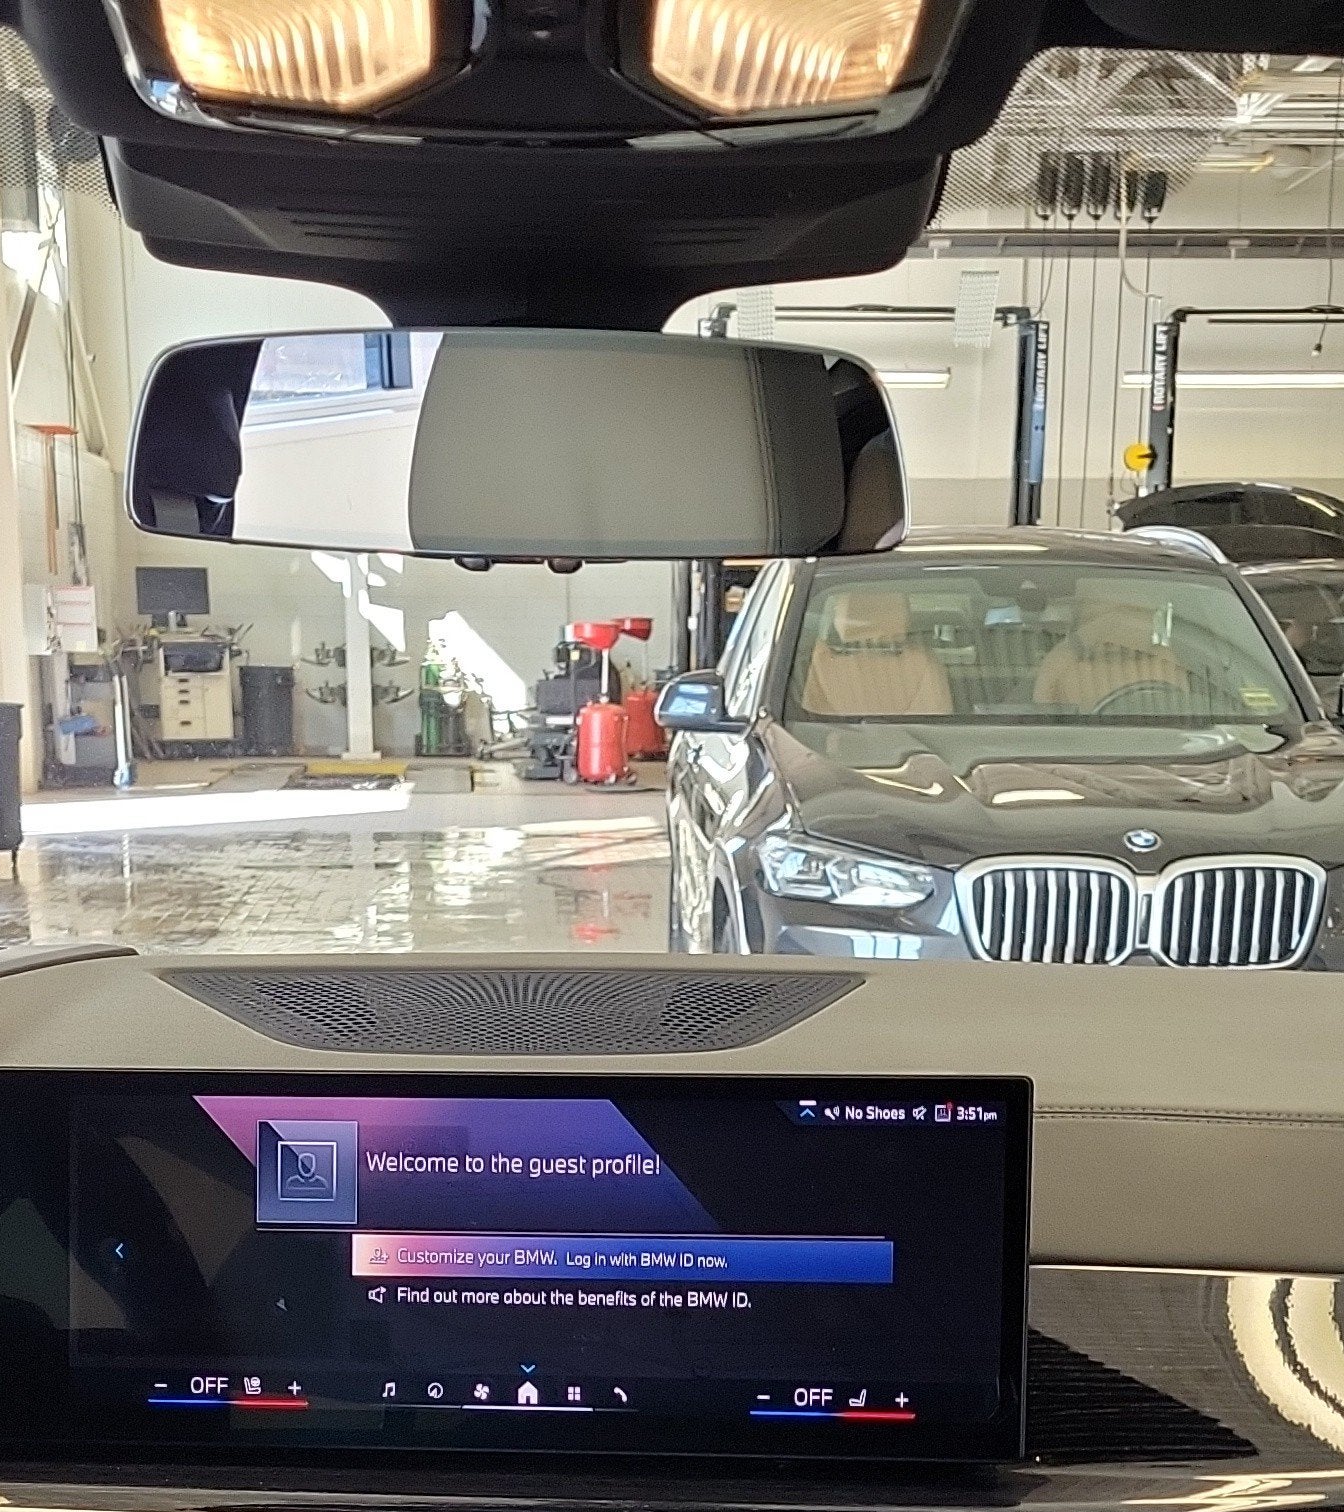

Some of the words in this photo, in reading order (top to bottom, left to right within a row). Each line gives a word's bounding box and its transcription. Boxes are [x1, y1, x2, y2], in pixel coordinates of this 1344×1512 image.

[1156, 324, 1169, 352] LIFT
[1153, 353, 1167, 405] ROTARY
[845, 1106, 863, 1120] No
[866, 1105, 905, 1120] Shoes
[366, 1151, 459, 1173] Welcome
[465, 1154, 484, 1173] to
[491, 1153, 523, 1173] the
[529, 1155, 586, 1178] guest
[592, 1154, 661, 1178] profile!
[397, 1248, 474, 1265] Customize
[477, 1252, 511, 1268] your
[514, 1249, 558, 1266] BMW.
[566, 1252, 591, 1268] Log
[595, 1252, 606, 1266] in
[610, 1252, 637, 1267] with
[640, 1252, 677, 1268] BMW
[680, 1253, 694, 1268] ID
[697, 1255, 728, 1268] now.
[397, 1286, 430, 1303] Find
[433, 1288, 458, 1304] out
[461, 1290, 500, 1304] more
[503, 1288, 547, 1305] about
[550, 1288, 574, 1306] the
[578, 1289, 637, 1307] benefits
[641, 1290, 656, 1307] of
[659, 1291, 683, 1307] the
[687, 1291, 728, 1308] BMW
[732, 1291, 752, 1308] ID.
[190, 1376, 229, 1394] OFF
[794, 1388, 833, 1407] OFF
